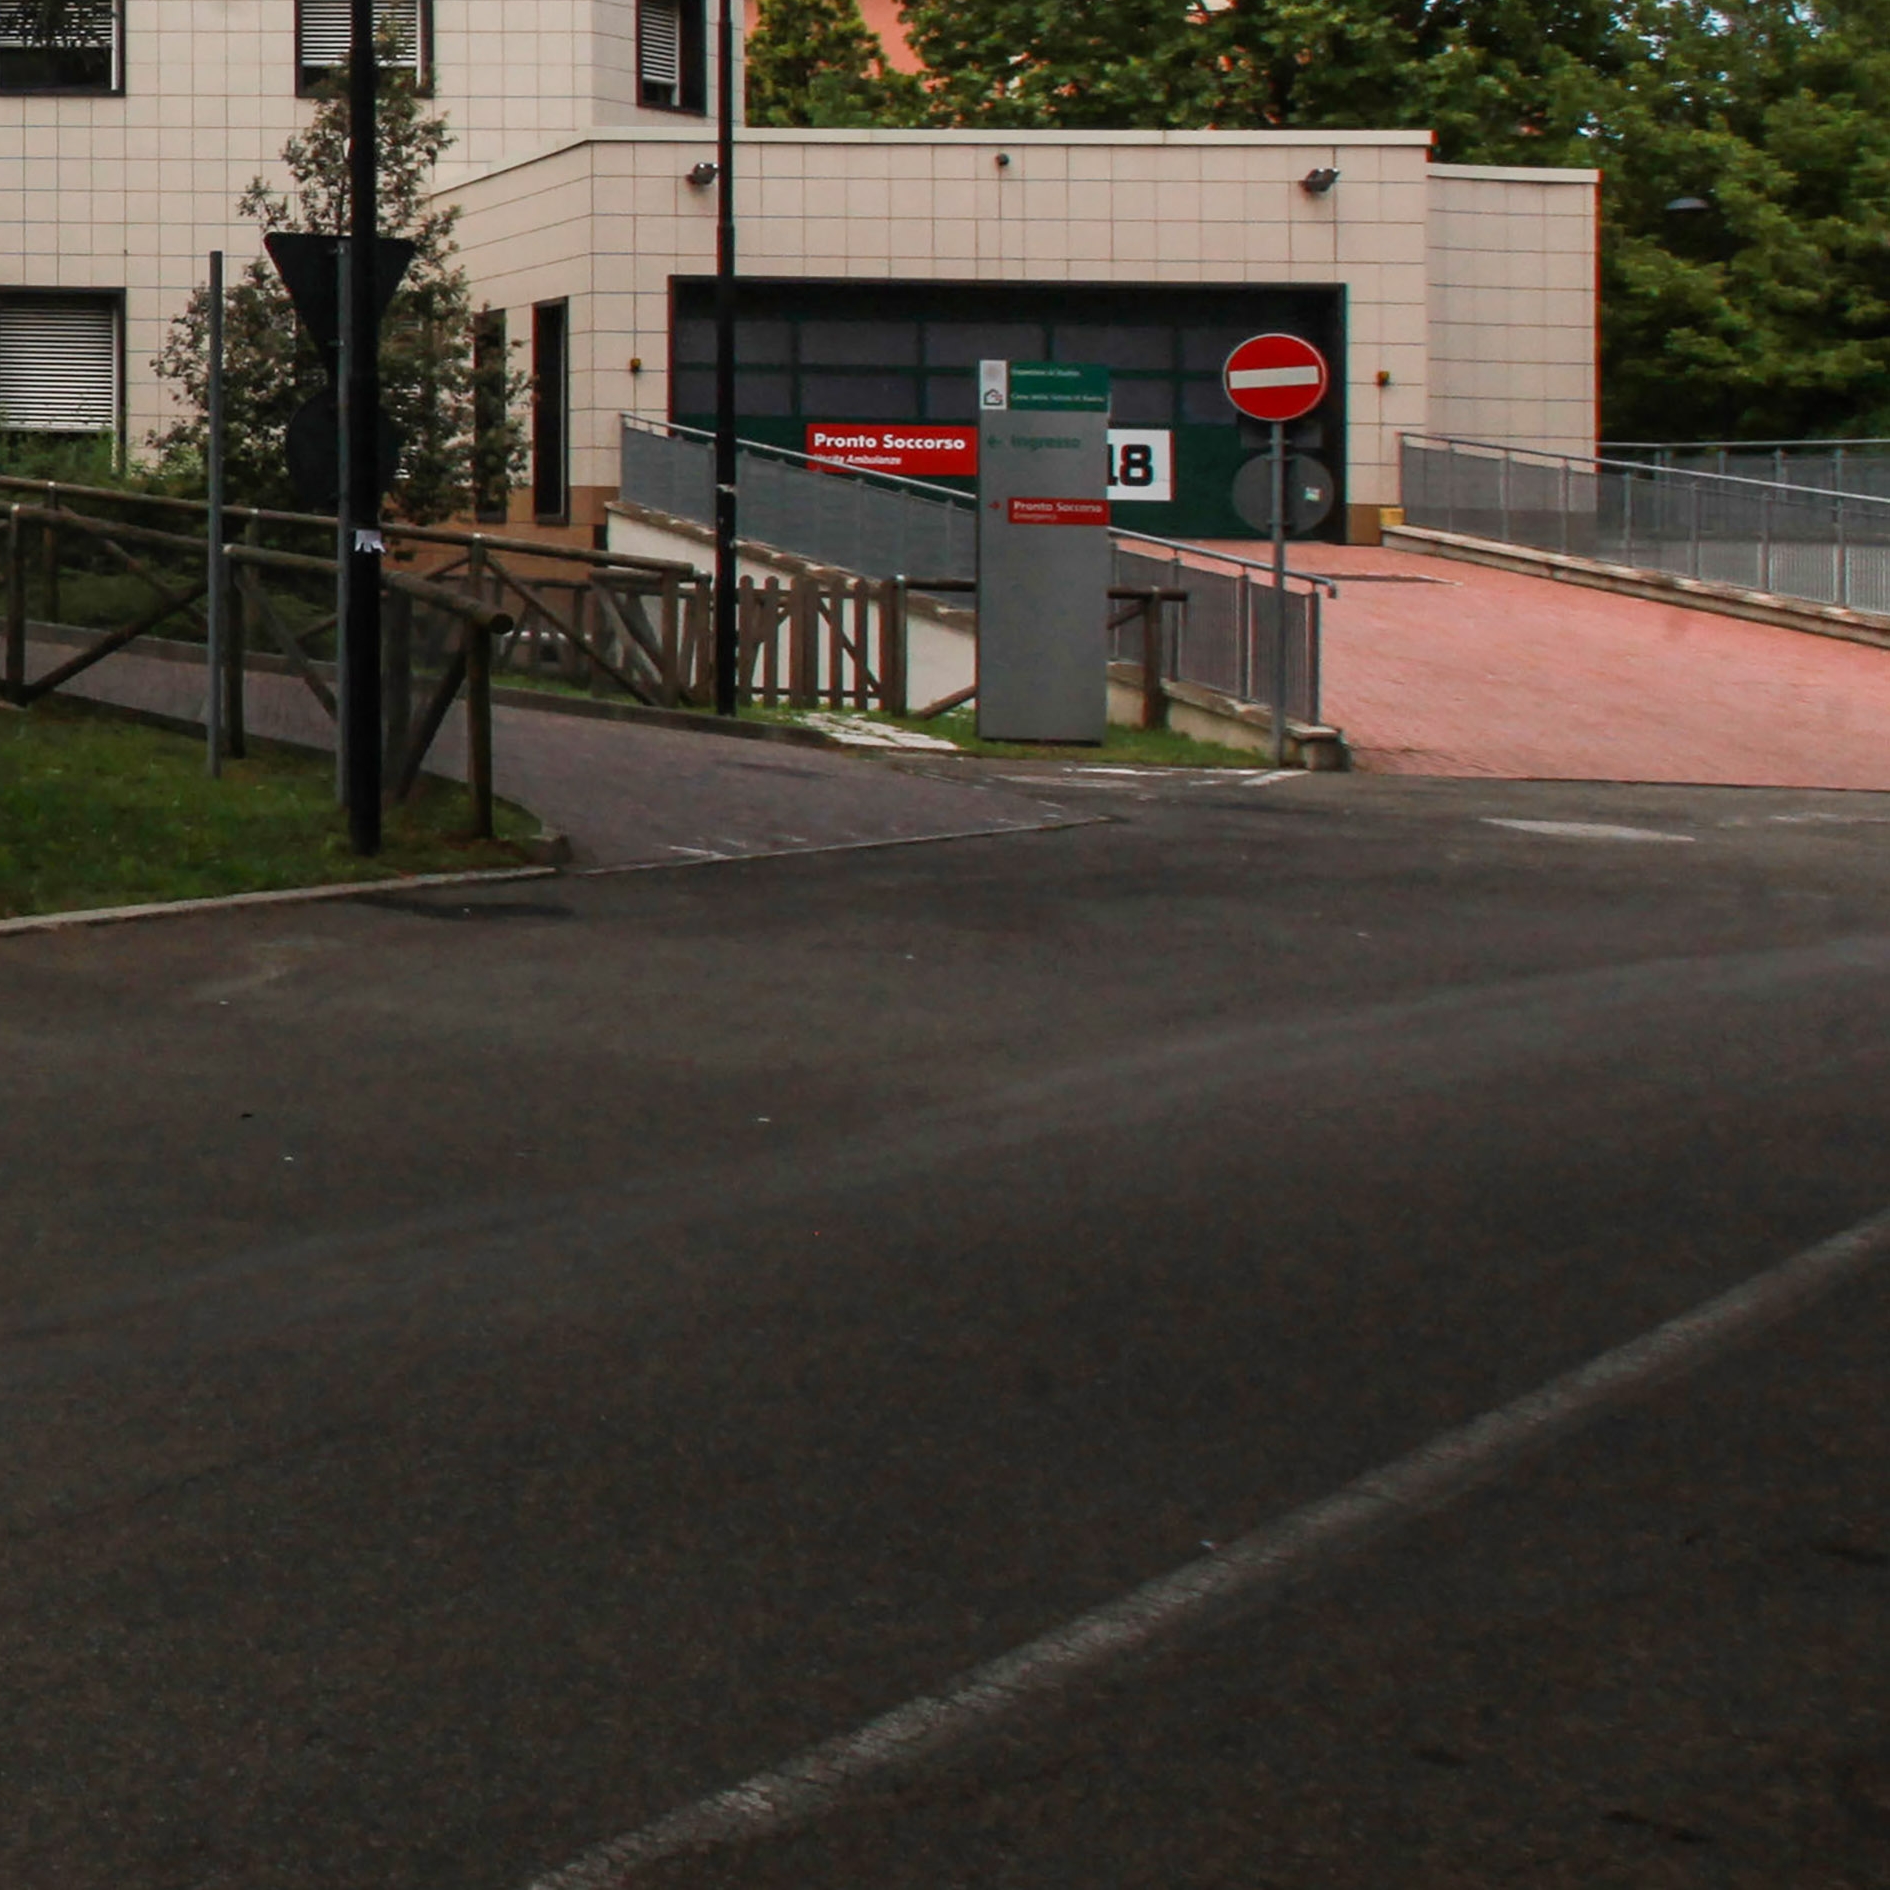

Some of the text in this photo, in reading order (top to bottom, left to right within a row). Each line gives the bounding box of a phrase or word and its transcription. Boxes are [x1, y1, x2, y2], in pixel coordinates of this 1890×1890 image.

[813, 433, 966, 450] Pronto Soccorso
[1013, 500, 1053, 512] Pronto
